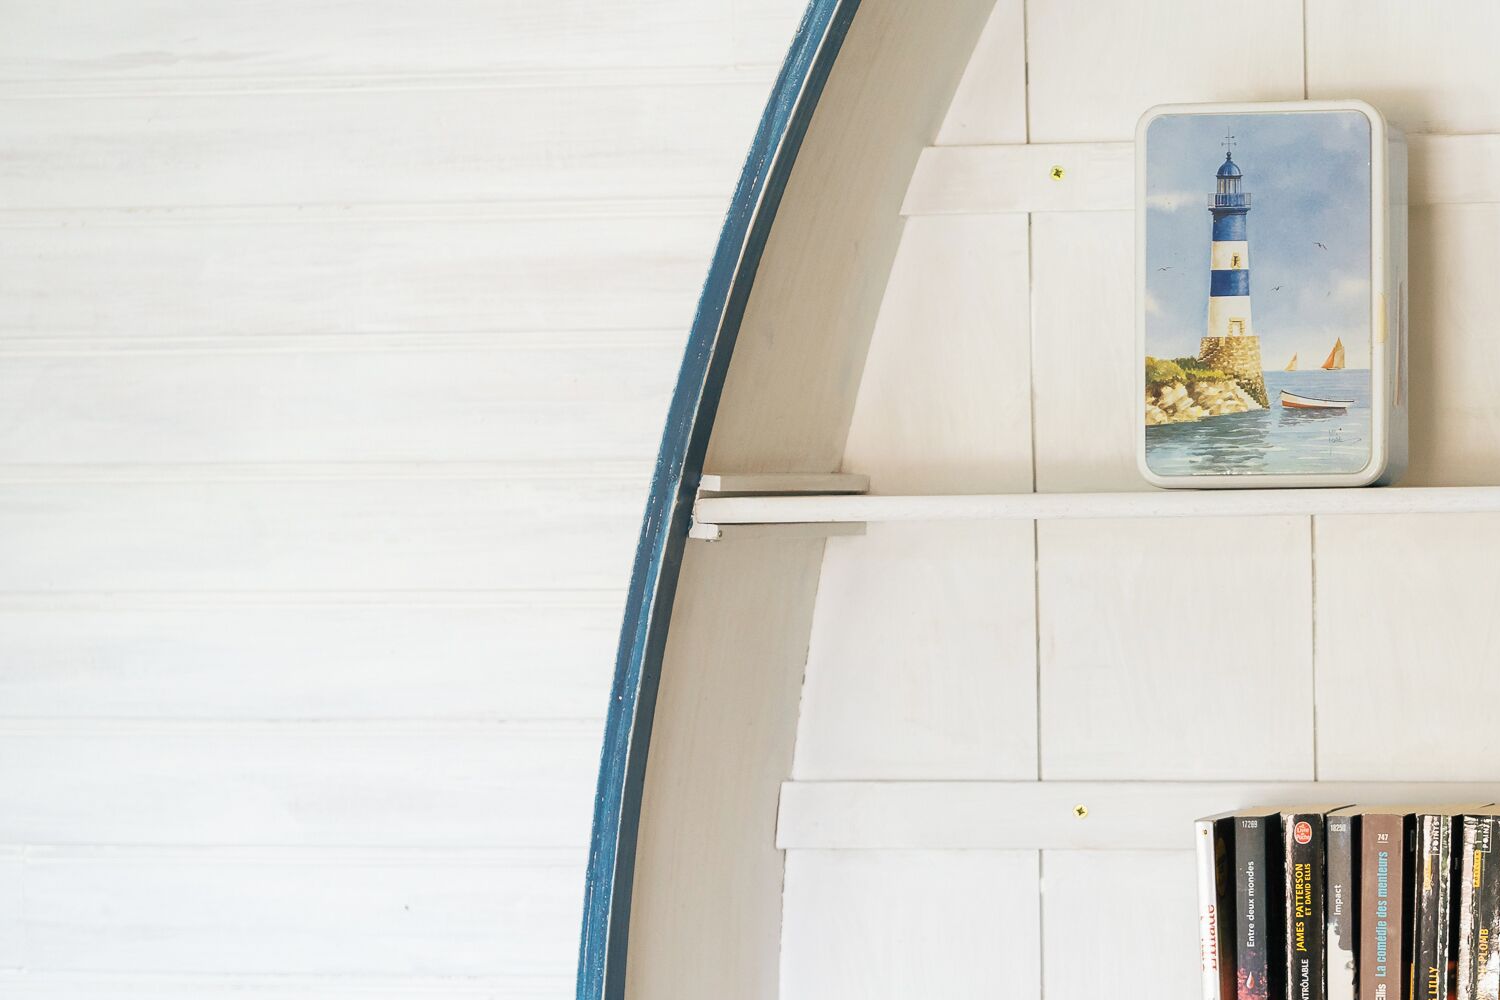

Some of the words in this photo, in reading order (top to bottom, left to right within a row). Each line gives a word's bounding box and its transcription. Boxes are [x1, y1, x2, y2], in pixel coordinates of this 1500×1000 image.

[1246, 861, 1255, 897] mondes
[1377, 851, 1389, 898] menteurs
[1296, 864, 1304, 918] PATTERSON
[1334, 885, 1343, 916] Impact
[1246, 899, 1255, 921] deux
[1305, 905, 1311, 916] ET
[1376, 900, 1388, 918] des
[1246, 922, 1255, 947] Entre
[1296, 922, 1306, 951] JAMES
[1375, 921, 1388, 962] comédie
[1478, 928, 1489, 963] PLOMB
[1375, 965, 1386, 978] La
[1429, 966, 1439, 995] LILLY
